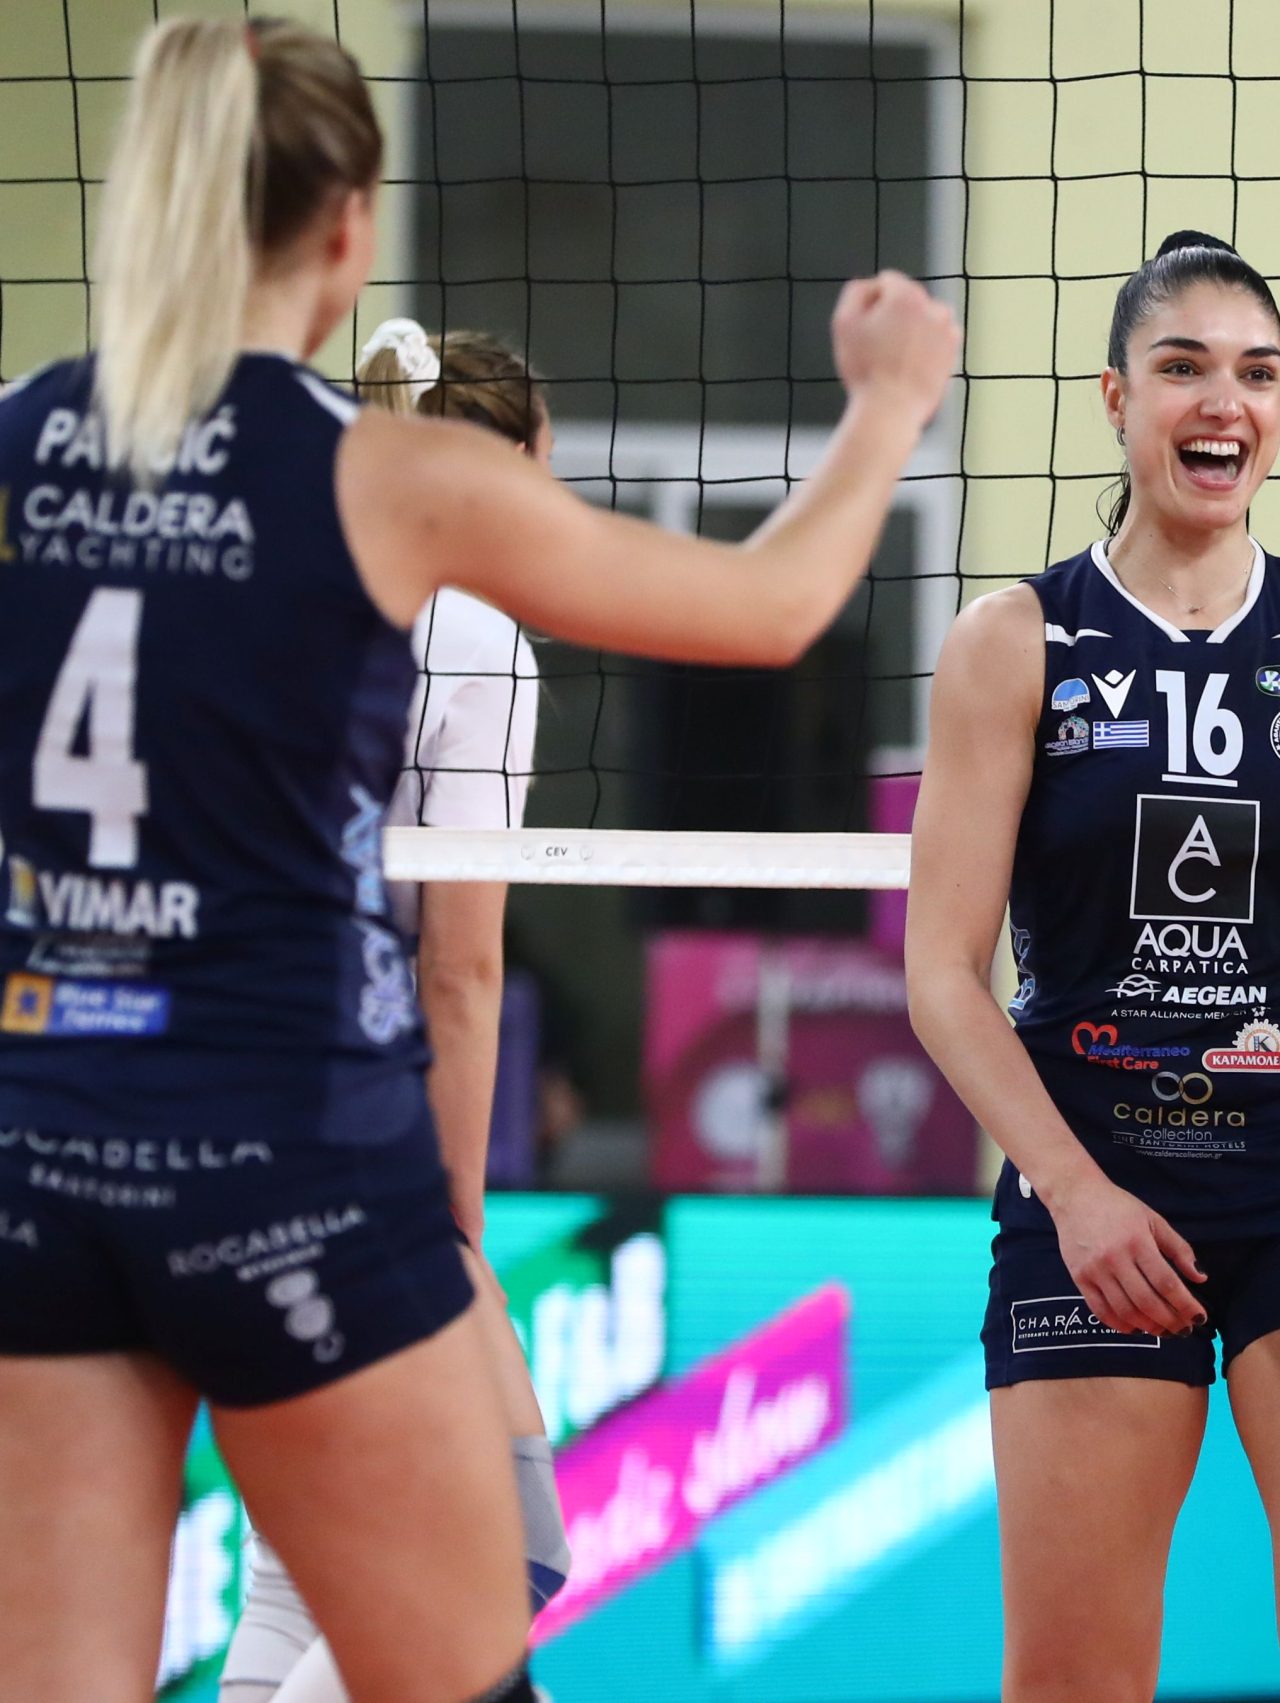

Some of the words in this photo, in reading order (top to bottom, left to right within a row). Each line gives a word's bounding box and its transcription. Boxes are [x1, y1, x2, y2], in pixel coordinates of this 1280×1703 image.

[23, 484, 256, 544] CALDERA
[18, 532, 254, 581] YACHTING
[32, 586, 149, 869] 4
[1155, 669, 1244, 776] 16
[545, 846, 568, 857] CEV
[38, 870, 200, 941] VIMAR
[1133, 922, 1248, 960] AQUA
[1131, 956, 1248, 975] CARPATICA
[1162, 986, 1267, 1006] AEGEAN
[1111, 1009, 1118, 1017] A
[1120, 1010, 1147, 1018] STAR
[1149, 1011, 1201, 1019] ALLIANCE
[1123, 1057, 1159, 1070] Care
[1113, 1103, 1246, 1127] caldera
[1143, 1128, 1212, 1141] collection
[166, 1205, 367, 1279] ROCABELLA
